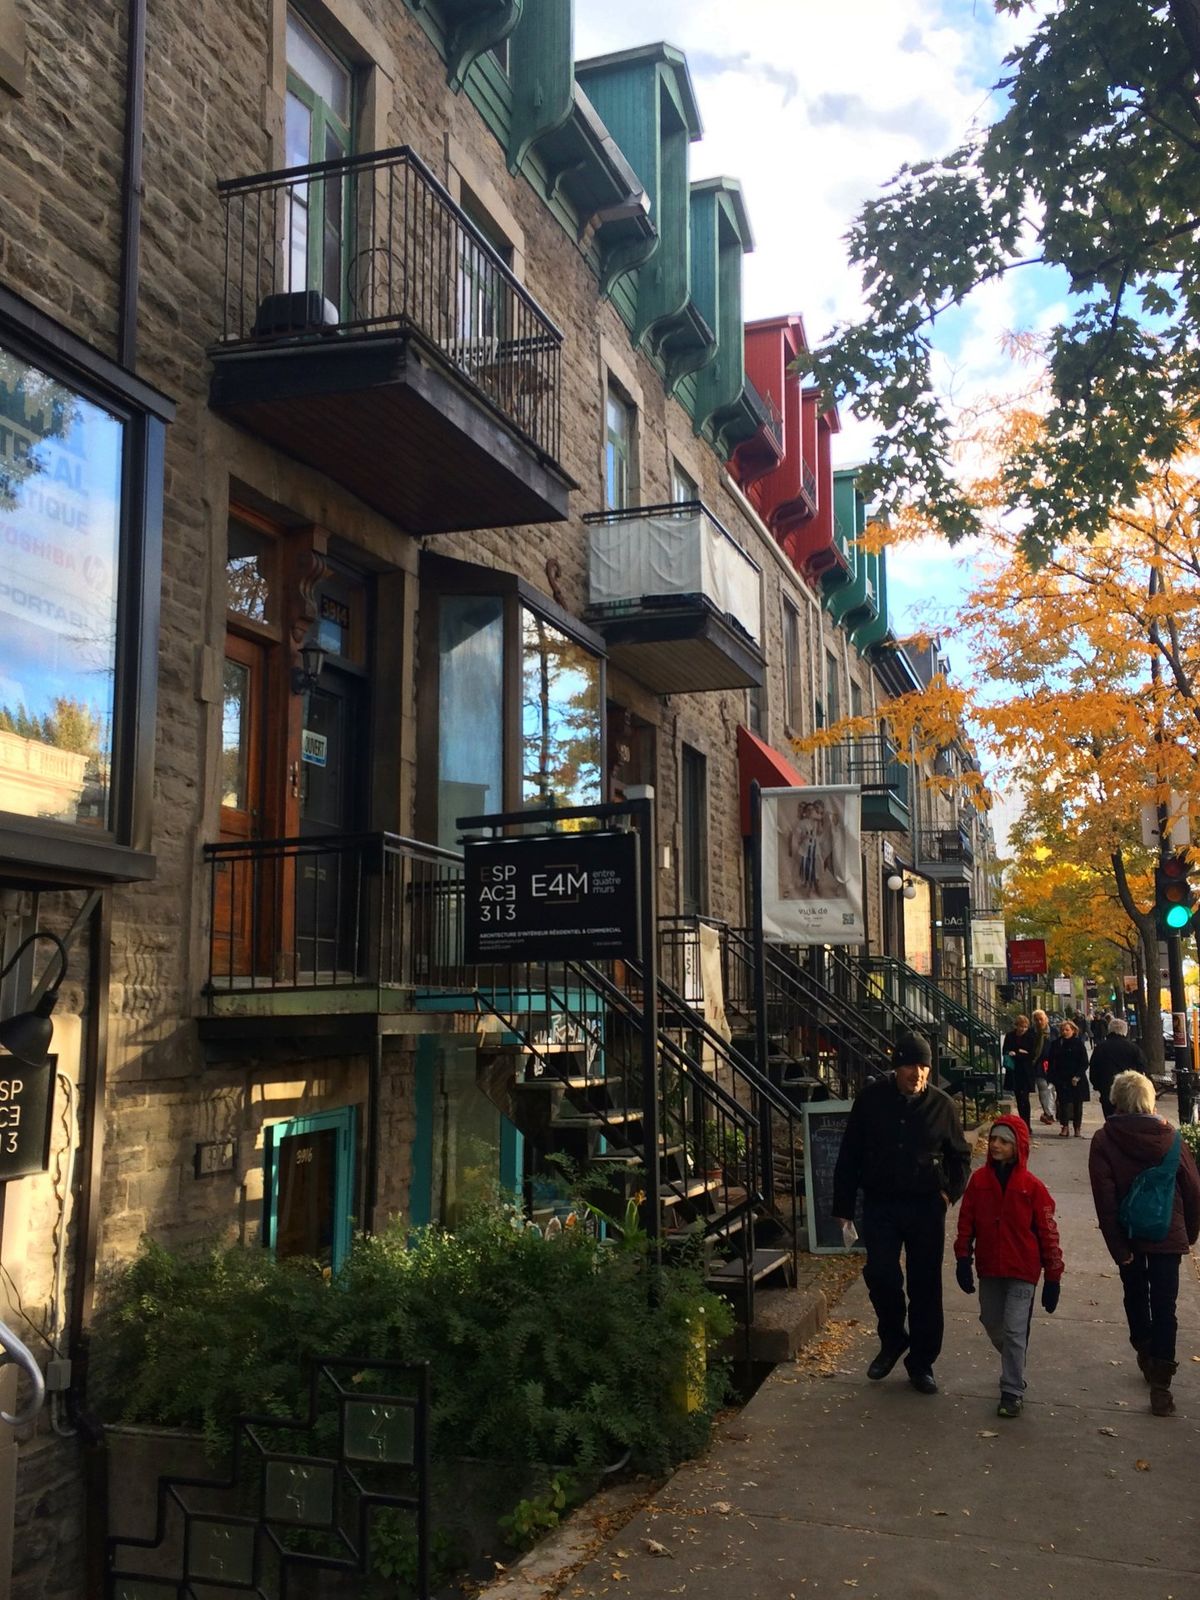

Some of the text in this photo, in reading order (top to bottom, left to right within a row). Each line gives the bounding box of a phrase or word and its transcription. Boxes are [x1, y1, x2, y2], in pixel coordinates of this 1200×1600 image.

[480, 865, 517, 882] ESP
[592, 870, 616, 879] entre
[532, 871, 587, 897] E4M
[592, 877, 621, 887] quatre
[592, 886, 616, 894] murs
[480, 904, 516, 921] 313
